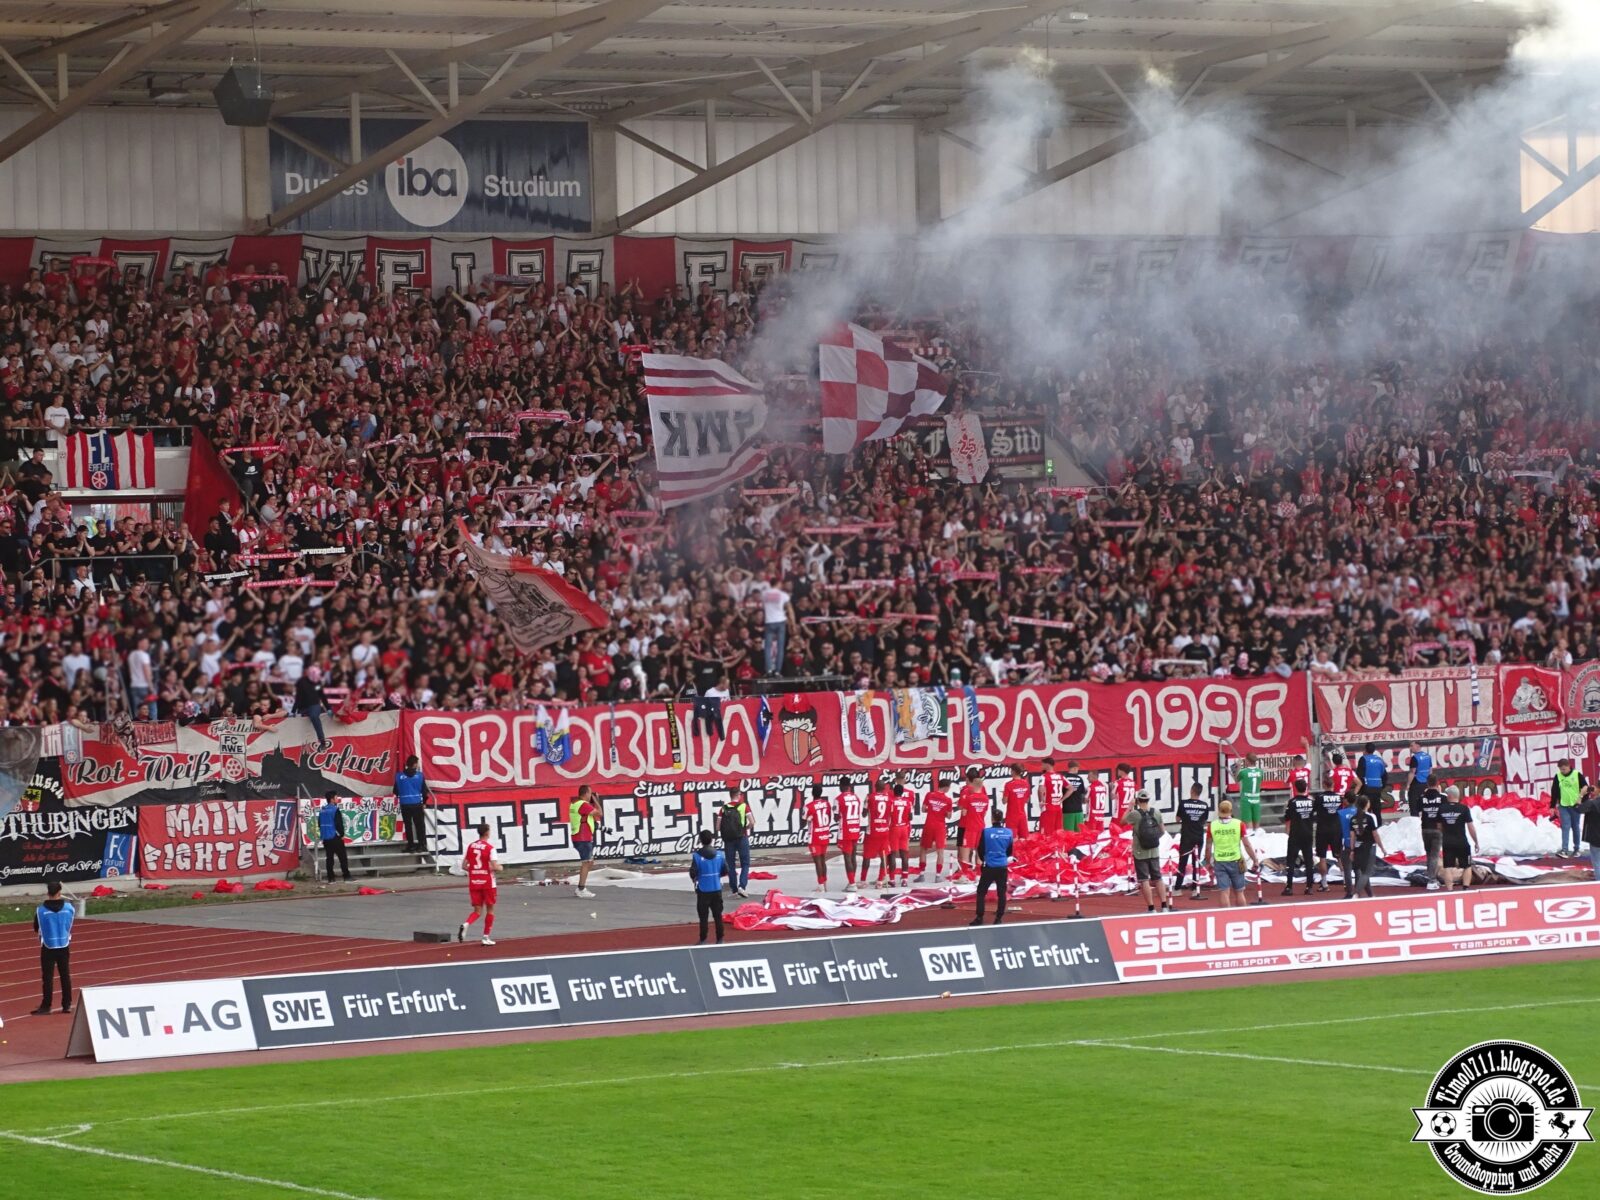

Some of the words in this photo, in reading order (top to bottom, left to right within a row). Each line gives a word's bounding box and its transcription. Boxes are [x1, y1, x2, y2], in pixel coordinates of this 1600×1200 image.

[285, 173, 368, 196] Dues
[397, 157, 457, 197] iba
[484, 174, 581, 197] Studium
[991, 426, 1041, 456] Süd
[1126, 682, 1289, 750] 1996
[224, 735, 238, 745] FC
[308, 738, 391, 775] Erfurt
[634, 780, 675, 798] Einst
[939, 766, 961, 784] und
[1339, 776, 1348, 793] 5
[877, 801, 887, 819] 9
[1095, 792, 1106, 810] 19
[1322, 795, 1341, 803] RWE
[165, 799, 250, 838] MAIN
[816, 808, 829, 827] 16
[896, 806, 905, 823] 7
[142, 837, 281, 872] FIGHTER
[473, 849, 483, 869] 3
[634, 837, 664, 856] dem
[1387, 900, 1519, 936] saller
[1134, 918, 1274, 955] saller
[783, 962, 820, 987] Für
[825, 956, 899, 982] Erfurt.
[928, 949, 976, 976] SWE
[989, 946, 1026, 971] Für
[1029, 942, 1101, 968] Erfurt.
[568, 977, 607, 1003] Für
[611, 971, 687, 998] Erfurt.
[718, 964, 768, 990] SWE
[343, 992, 384, 1019] Für
[388, 987, 467, 1016] Erfurt.
[500, 980, 553, 1008] SWE
[97, 998, 242, 1040] NT.AG
[272, 995, 327, 1025] SWE
